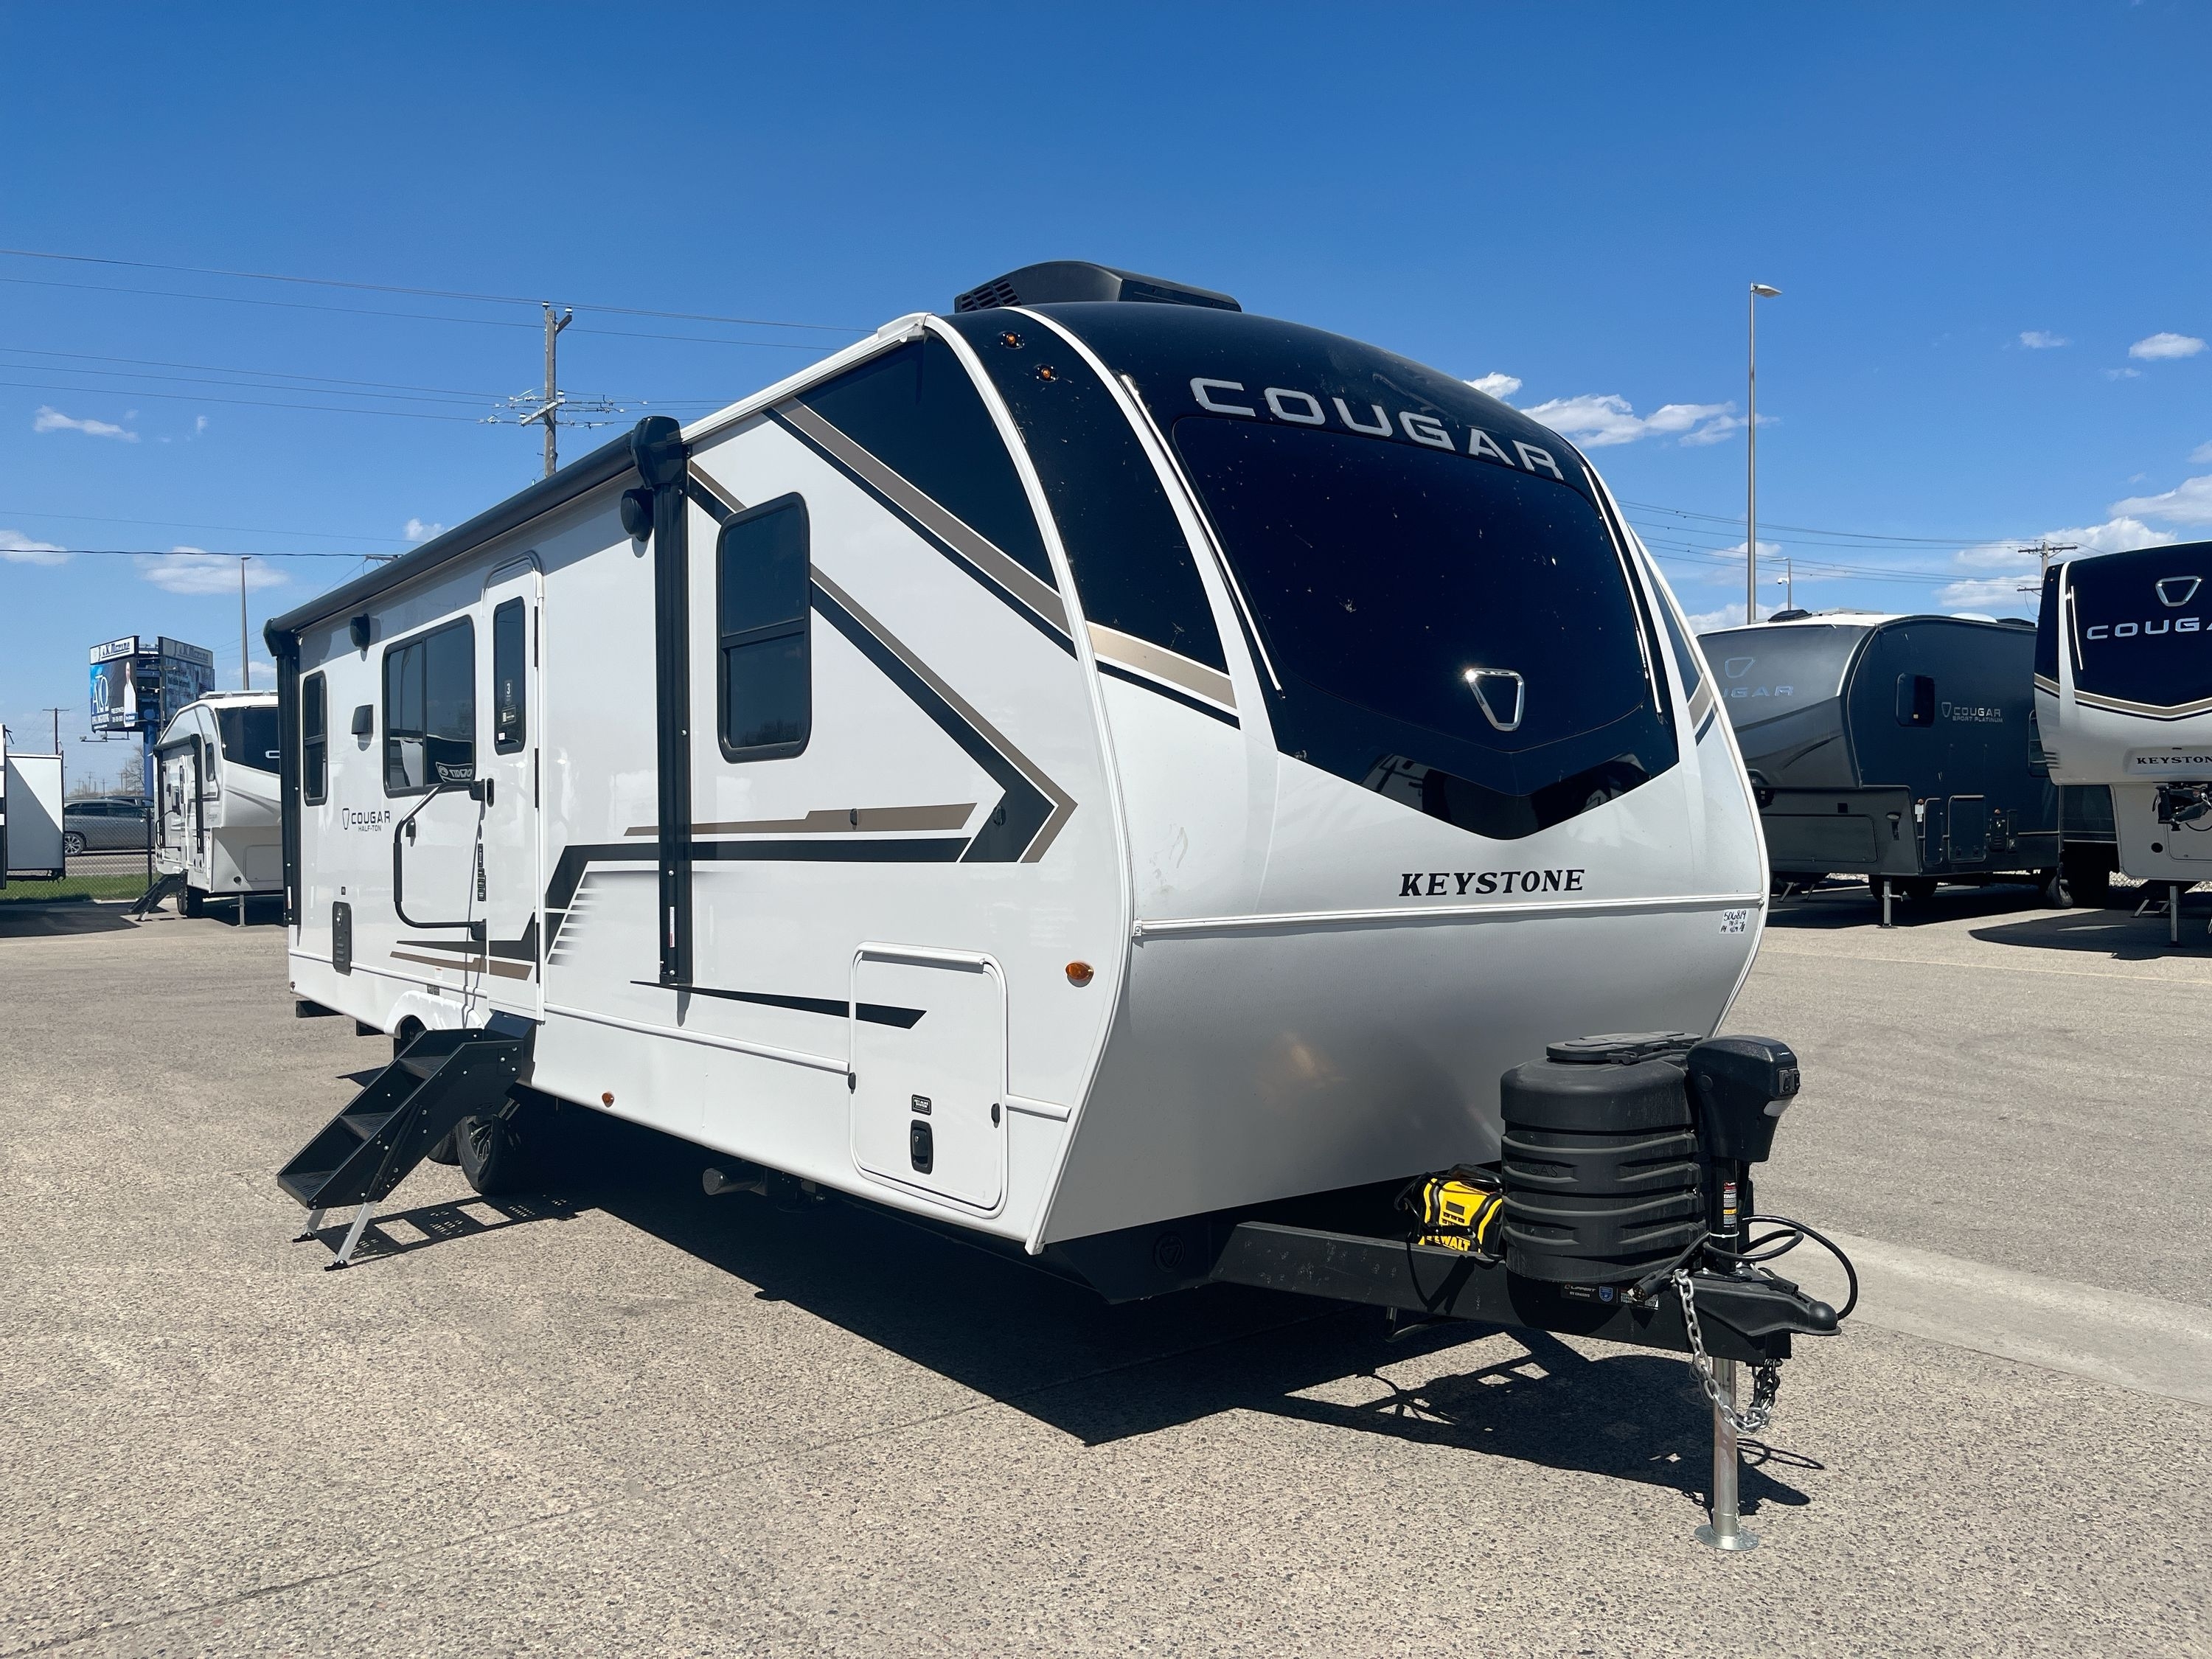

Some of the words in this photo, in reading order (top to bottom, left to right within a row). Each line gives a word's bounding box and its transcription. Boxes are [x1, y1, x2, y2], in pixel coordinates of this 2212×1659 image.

[1189, 377, 1565, 481] COUGAR
[2086, 617, 2212, 640] COUG
[1953, 706, 2001, 717] COUGAR
[351, 810, 391, 824] COUGAR
[358, 824, 382, 832] HALF-TON
[1399, 869, 1585, 897] KEYSTONE
